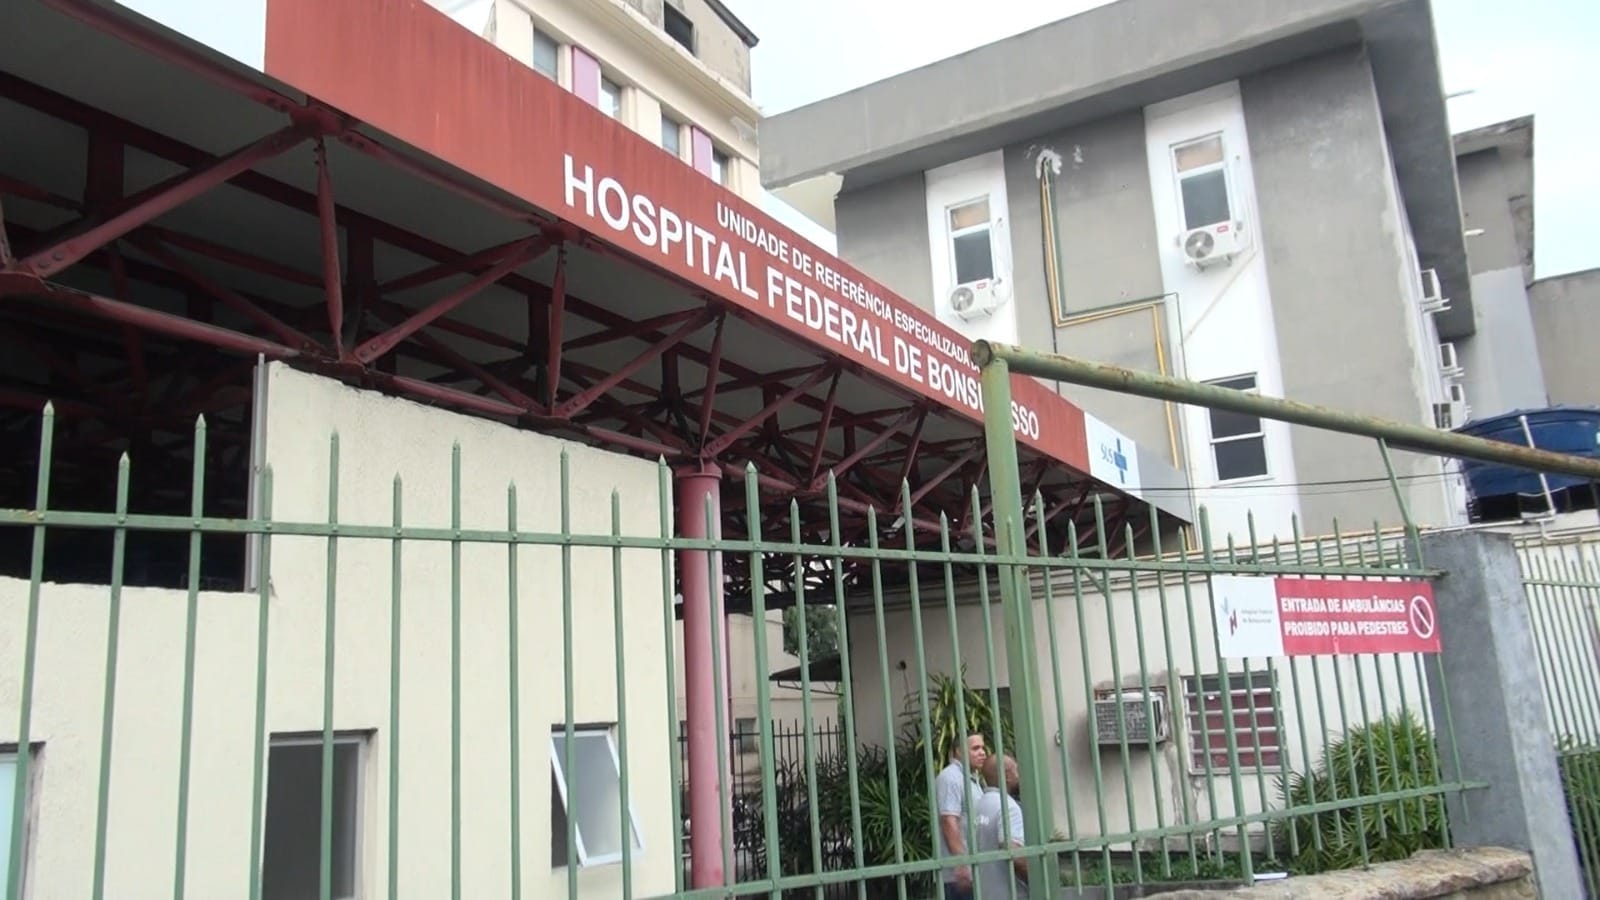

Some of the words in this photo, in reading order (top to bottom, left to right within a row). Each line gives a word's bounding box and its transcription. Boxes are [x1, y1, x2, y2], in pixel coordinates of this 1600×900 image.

[564, 153, 759, 300] HOSPITAL
[767, 265, 889, 366] FEDERAL
[894, 335, 923, 383] DE
[927, 354, 1039, 440] BONSSSO
[717, 201, 789, 264] UNIDADE
[792, 247, 812, 277] DE
[815, 261, 893, 324] REFERÊNCIA
[894, 308, 970, 367] ESPECIALIZADA
[1280, 597, 1327, 612] ENTRADA
[1327, 598, 1340, 612] DE
[1342, 595, 1406, 613] AMBULÂNCIAS
[1284, 620, 1329, 636] PROIBIDO
[1331, 621, 1357, 636] PARA
[1357, 620, 1408, 636] PEDESTRES
